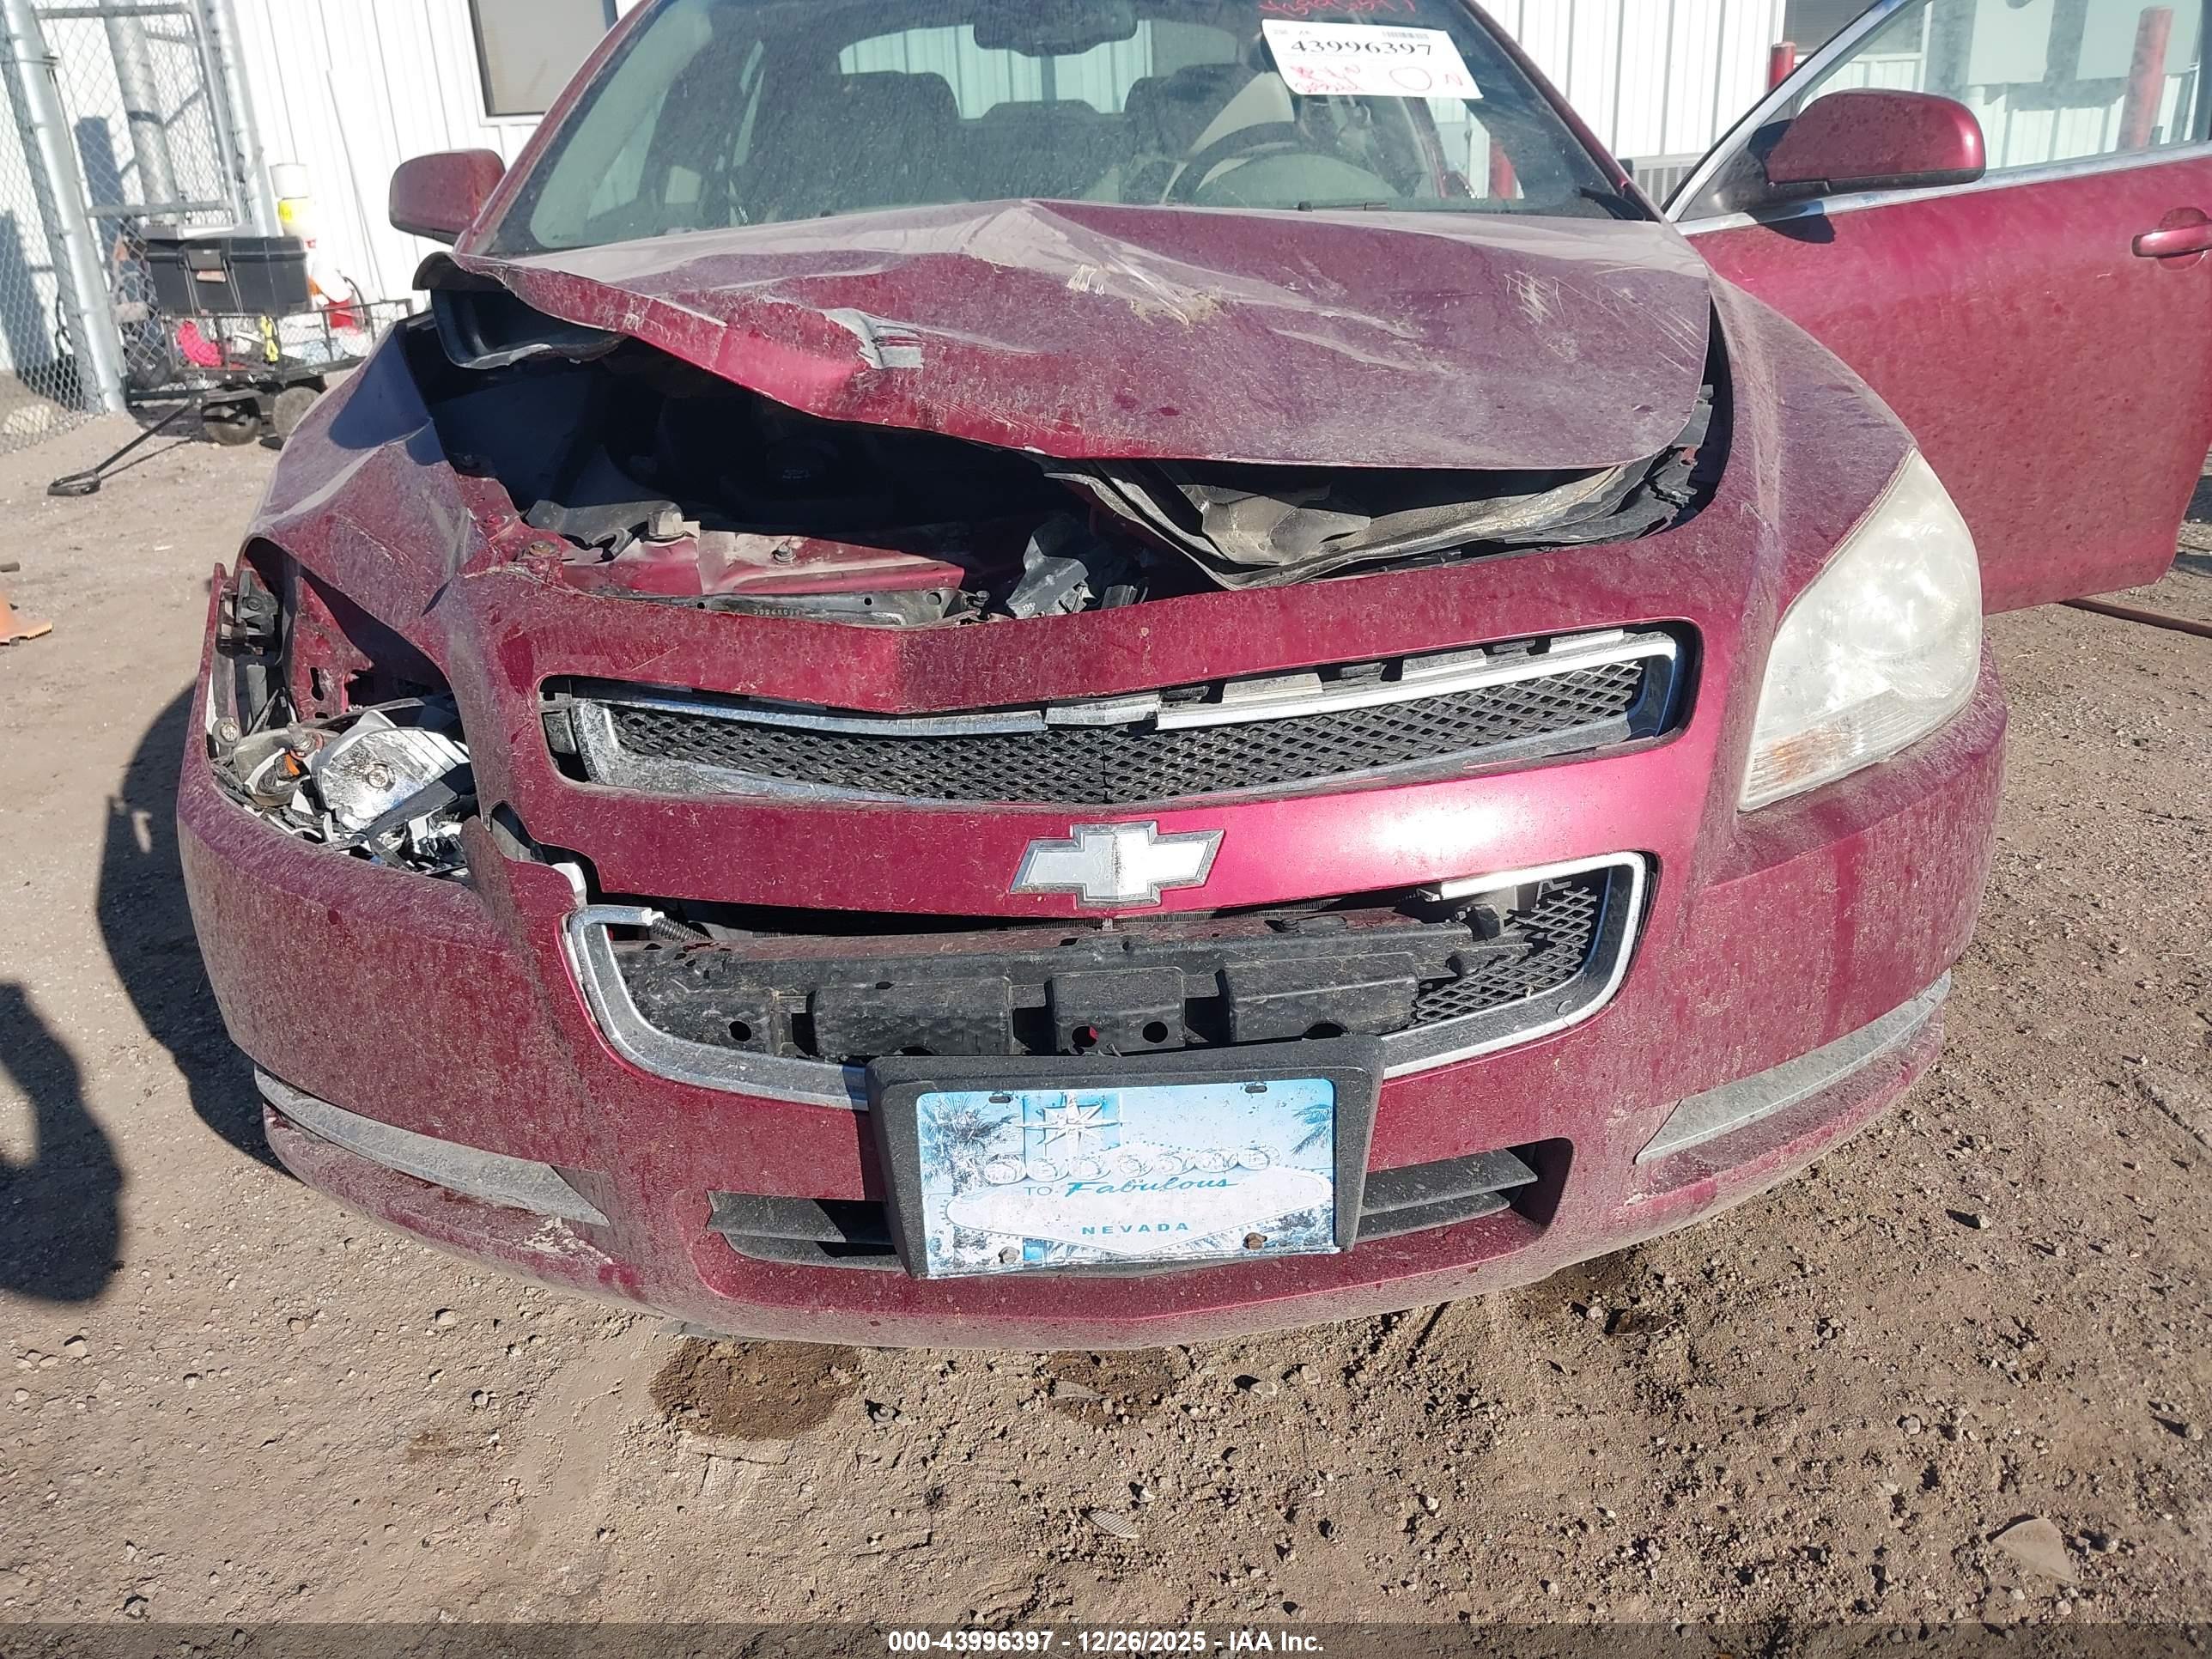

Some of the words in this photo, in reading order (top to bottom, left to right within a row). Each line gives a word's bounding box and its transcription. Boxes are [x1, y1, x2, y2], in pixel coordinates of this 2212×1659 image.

[1291, 40, 1431, 56] 43996397
[1024, 1186, 1052, 1196] TO
[1065, 1176, 1238, 1198] Fabulous
[1082, 1222, 1188, 1235] NEVADA
